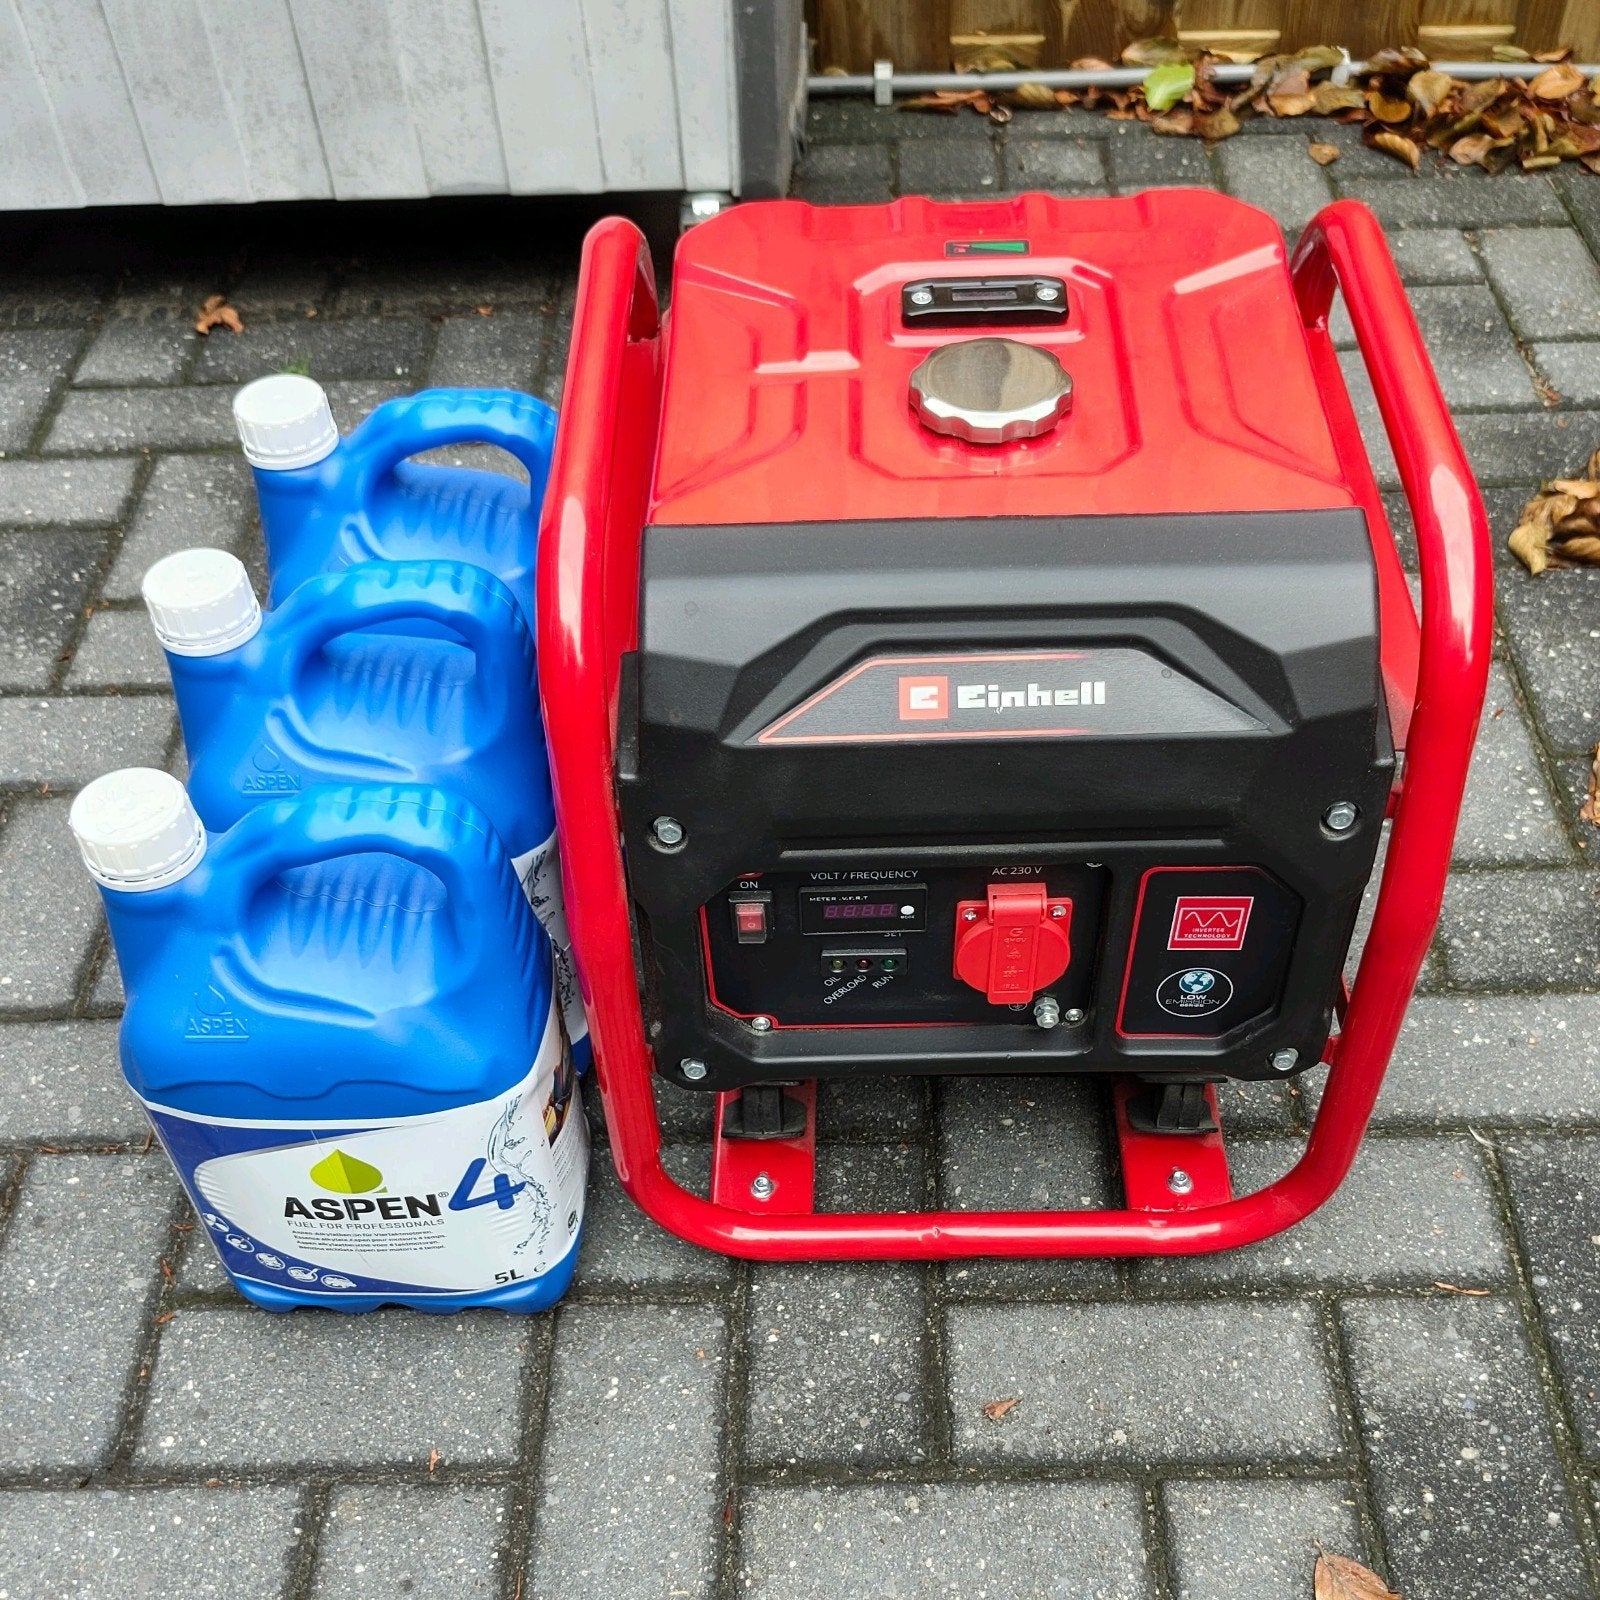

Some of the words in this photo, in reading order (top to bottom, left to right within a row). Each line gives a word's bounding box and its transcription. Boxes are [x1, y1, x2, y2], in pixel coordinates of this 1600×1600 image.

[957, 681, 1106, 709] Einhell
[242, 773, 302, 791] ASPEN
[810, 872, 840, 880] VOLT
[850, 870, 919, 880] FREQUENCY
[991, 867, 1008, 876] AC
[1010, 866, 1032, 875] 230
[1034, 866, 1043, 874] V
[739, 881, 759, 889] ON
[823, 976, 841, 987] OIL
[823, 974, 867, 1005] OVERLOAD
[872, 974, 894, 989] RUN
[187, 1017, 249, 1034] ASPEN
[447, 1157, 527, 1212] 4
[286, 1220, 317, 1229] FUEL
[319, 1222, 343, 1230] FOR
[346, 1218, 445, 1230] PROFESSIONALS
[494, 1268, 525, 1286] 5L
